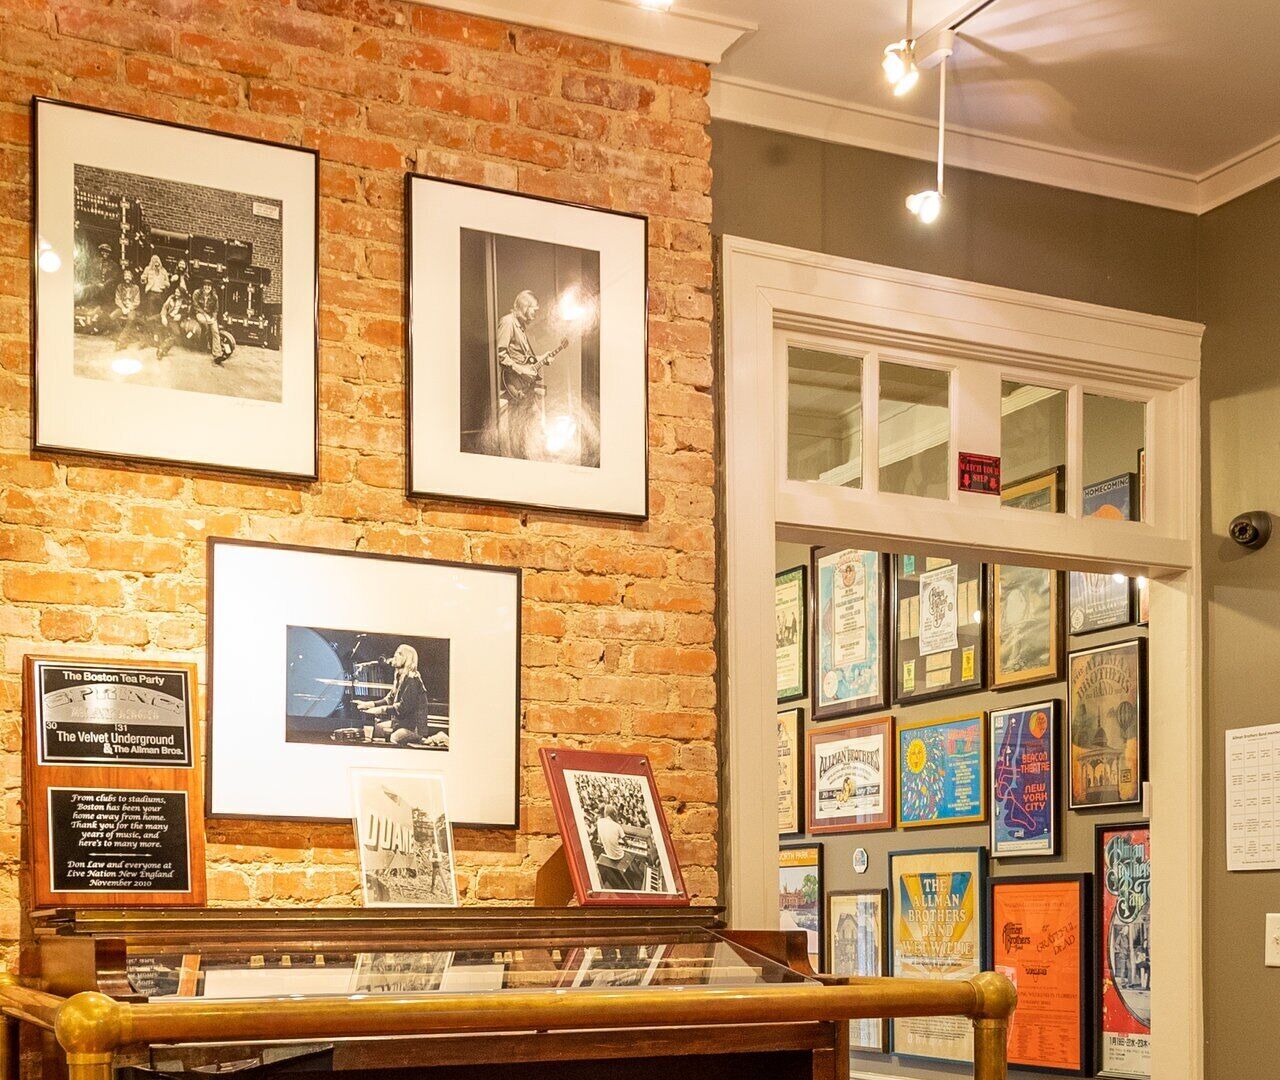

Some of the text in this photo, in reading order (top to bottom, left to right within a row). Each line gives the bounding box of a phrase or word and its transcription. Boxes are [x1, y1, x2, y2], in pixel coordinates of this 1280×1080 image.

[1084, 476, 1129, 498] HOMECOMING
[62, 670, 165, 687] The Boston Tea Party
[46, 721, 58, 730] 30
[56, 730, 175, 746] The Velvet Underground
[103, 742, 184, 756] & The Allman Bros.
[1021, 752, 1048, 764] BEACON
[820, 750, 847, 779] ALLMAN
[1020, 761, 1050, 774] THEATRE
[1024, 782, 1046, 793] NEW
[70, 794, 94, 803] From
[96, 793, 117, 802] clubs
[128, 795, 166, 804] stadiums,
[1023, 792, 1048, 803] YORK
[76, 803, 105, 811] Boston
[106, 803, 120, 811] has
[142, 806, 162, 814] your
[1024, 802, 1046, 813] CITY
[72, 812, 166, 822] home away from home.
[70, 820, 169, 832] Thank you for the many
[80, 832, 104, 840] years
[106, 830, 116, 840] of
[142, 831, 160, 839] and
[78, 839, 102, 847] here's
[113, 841, 138, 850] many
[66, 860, 85, 868] Don
[106, 860, 124, 868] and
[124, 862, 162, 872] everyone
[66, 870, 86, 878] Live
[86, 870, 116, 878] Nation
[139, 870, 176, 880] England
[88, 879, 132, 887] November
[923, 878, 947, 892] THE
[912, 894, 960, 908] ALLMAN
[908, 909, 966, 922] BROTHERS
[922, 924, 954, 937] BAND
[930, 940, 973, 955] WILLIE
[1053, 934, 1076, 956] DEAD
